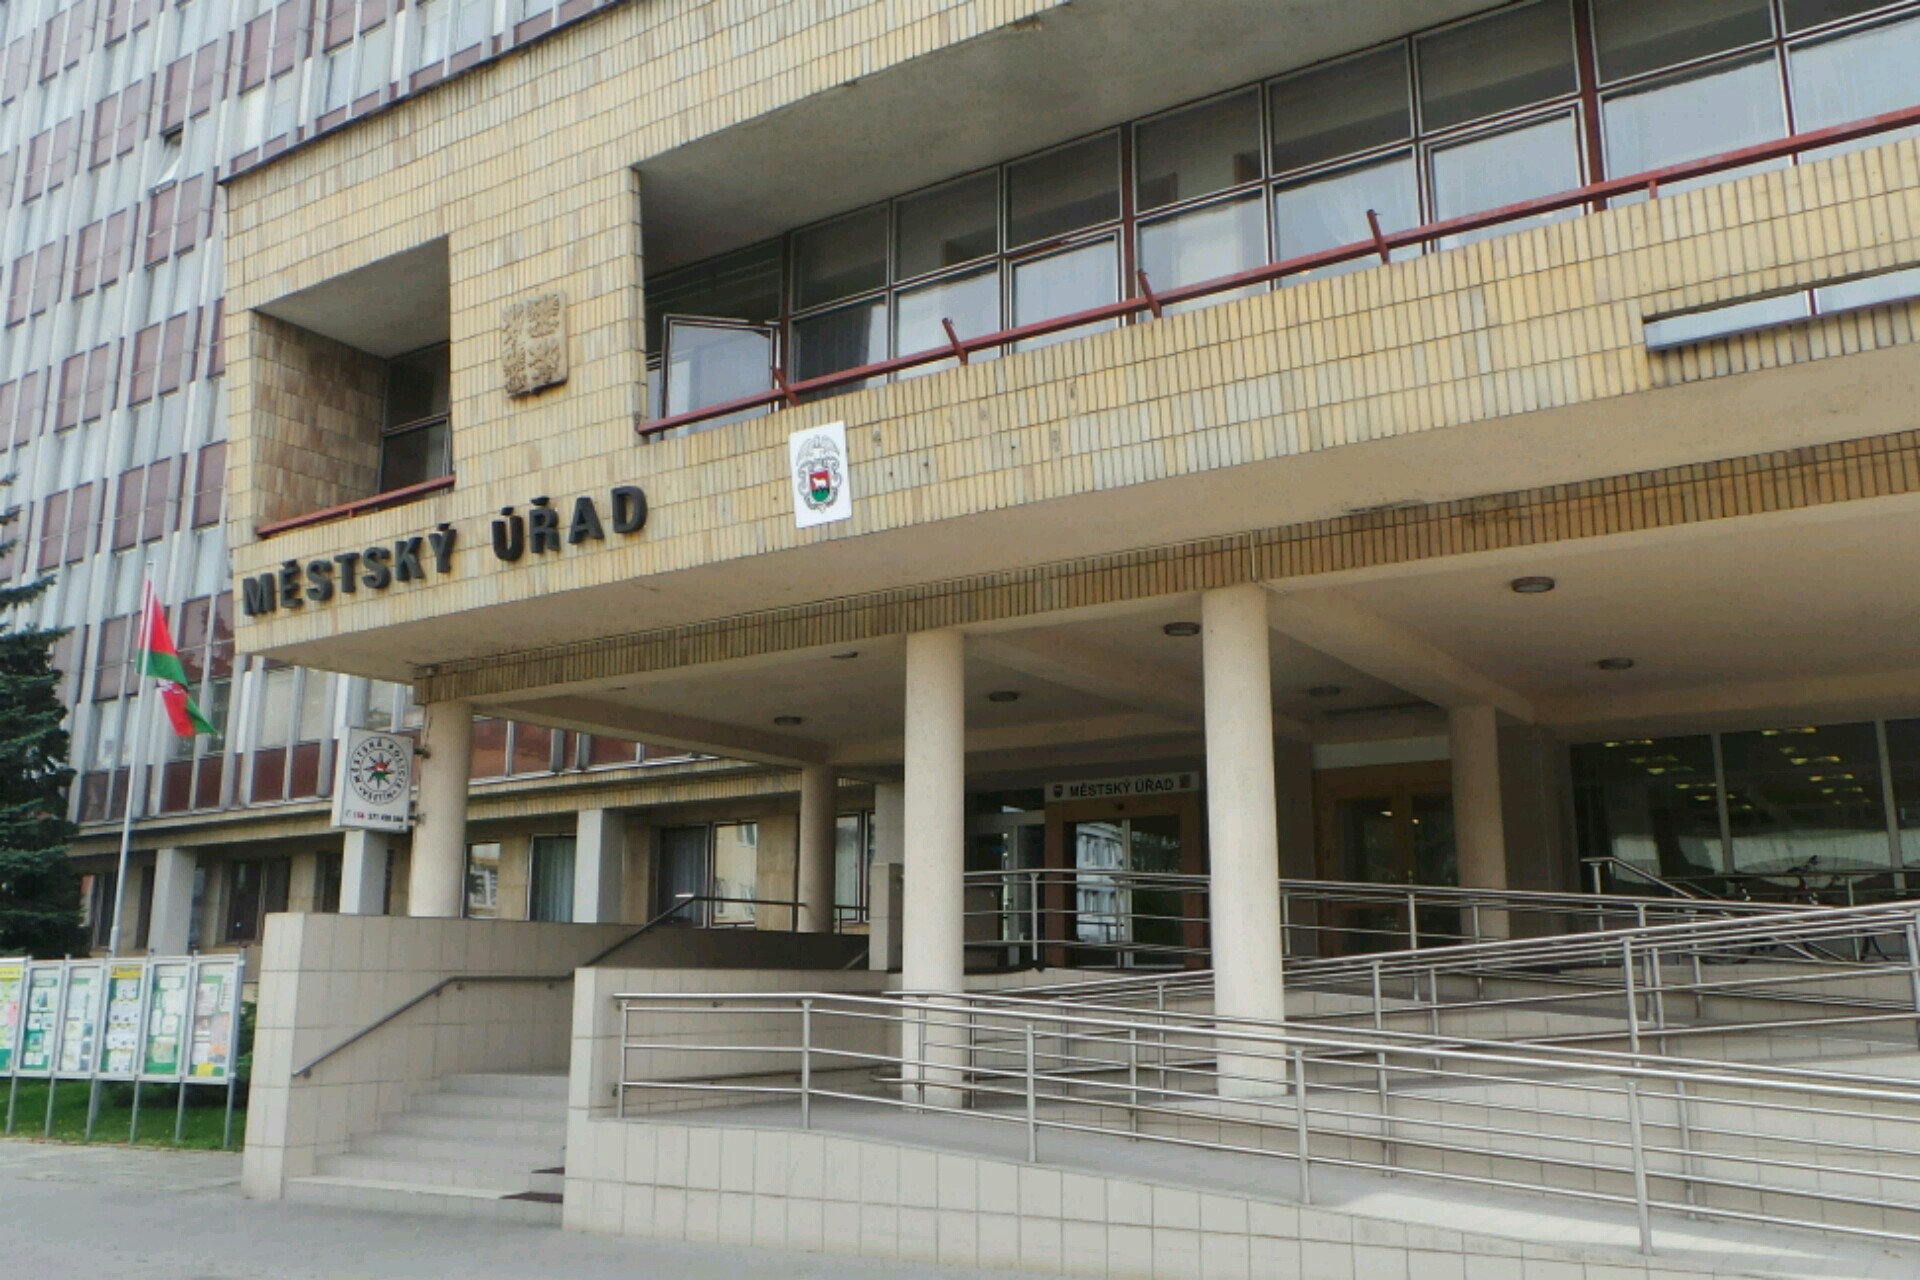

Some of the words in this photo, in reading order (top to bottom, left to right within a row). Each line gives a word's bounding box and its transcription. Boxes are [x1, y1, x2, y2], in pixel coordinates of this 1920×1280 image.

[242, 522, 457, 616] MĚSTSKÝ
[491, 485, 649, 562] ÚŘAD
[1070, 779, 1131, 797] MĚSTSKÝ
[1135, 777, 1174, 792] ÚŘAD
